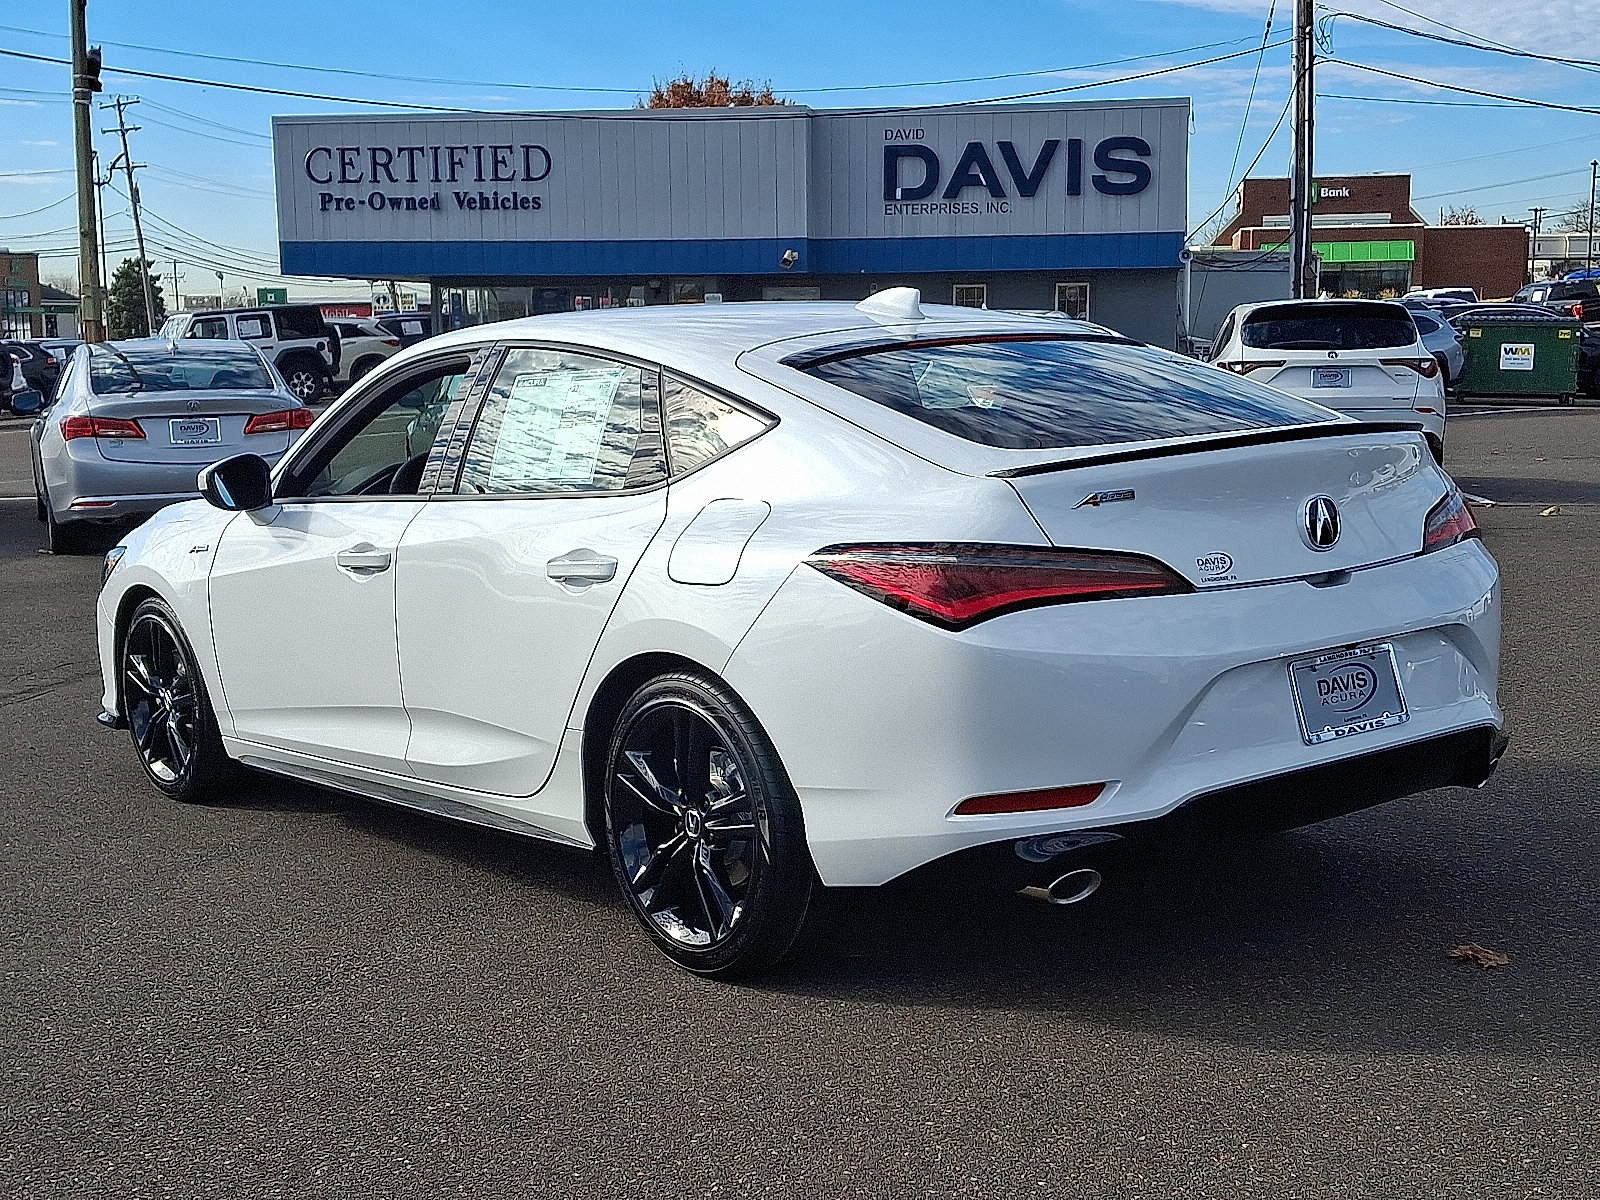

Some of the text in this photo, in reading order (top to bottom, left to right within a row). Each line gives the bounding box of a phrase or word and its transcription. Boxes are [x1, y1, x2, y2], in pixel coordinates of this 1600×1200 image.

[884, 129, 925, 141] DAVID
[304, 144, 553, 184] CERTIFIED
[883, 136, 1152, 201] DAVIS
[1320, 186, 1350, 198] Bank
[319, 191, 542, 212] Pre-Owned Vehicles
[884, 201, 1013, 215] ENTERPRISES, INC.
[1503, 346, 1531, 356] WM
[1196, 556, 1227, 567] DAVIS
[1198, 564, 1226, 572] ACURA
[1316, 671, 1368, 696] DAVIS
[1321, 689, 1367, 706] ACURA
[1335, 719, 1386, 737] DAVIS
